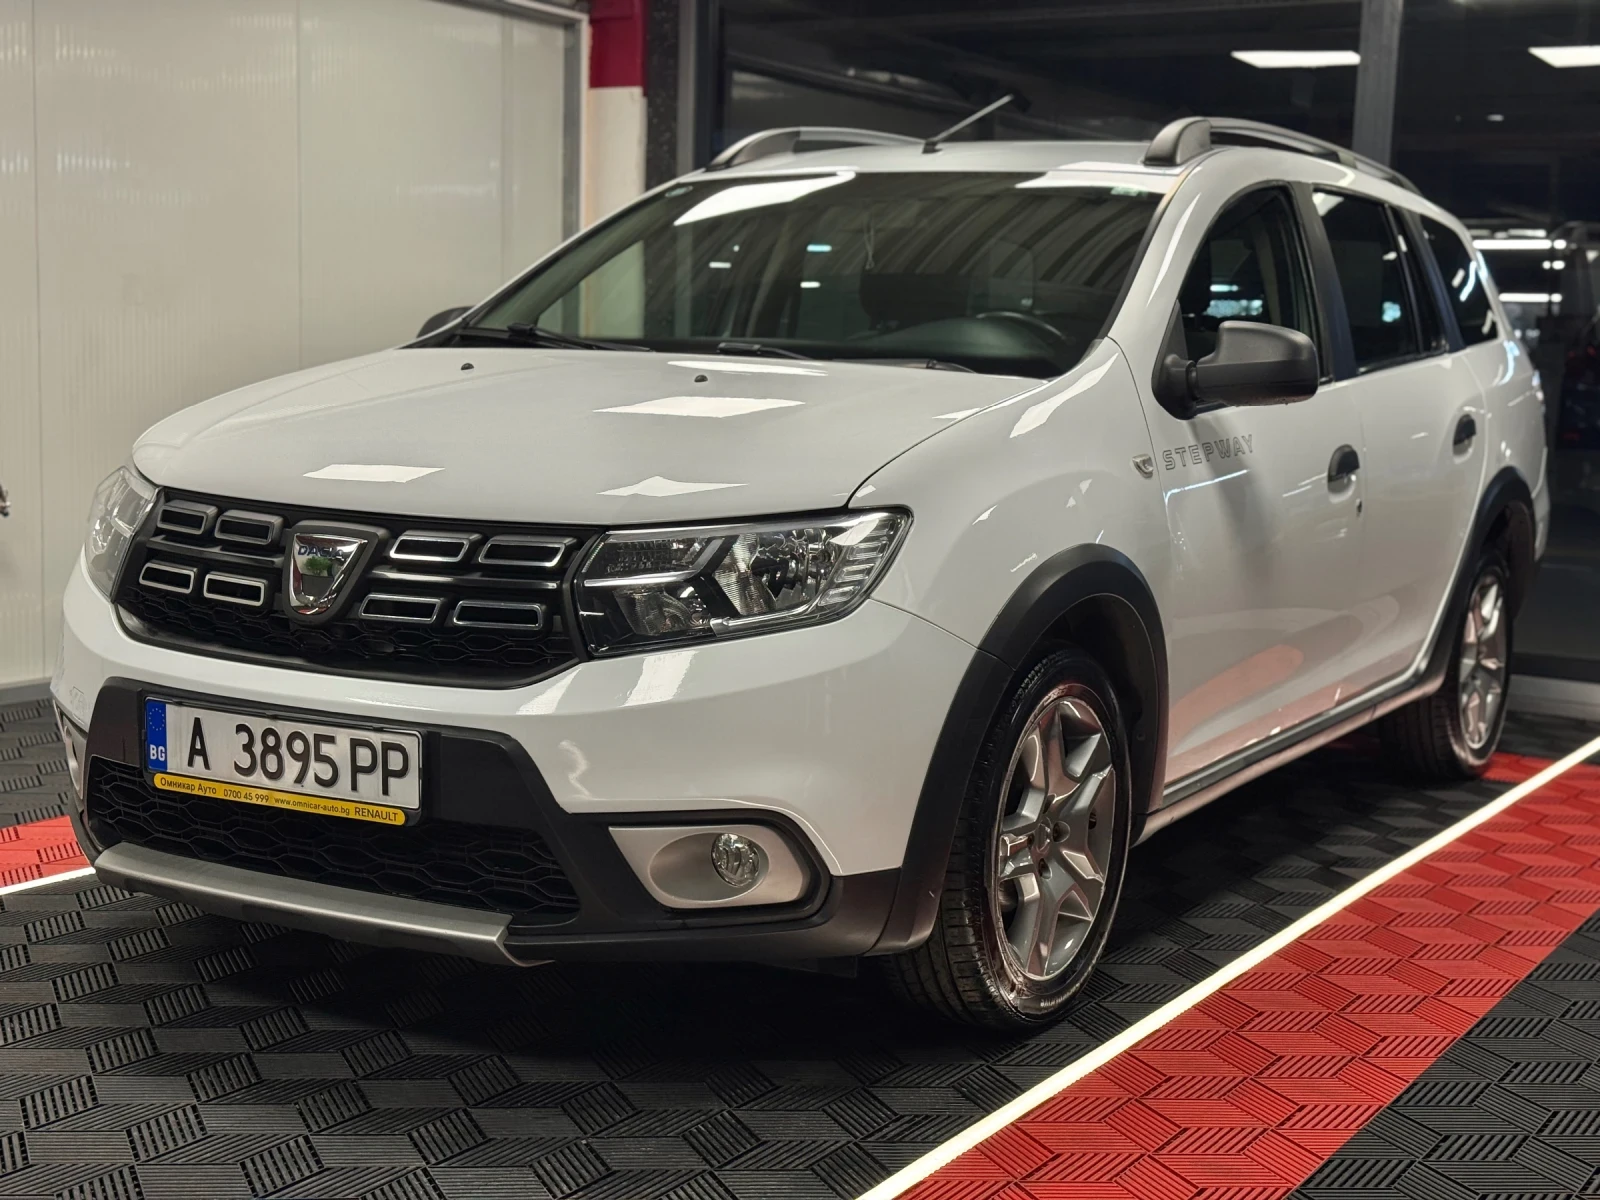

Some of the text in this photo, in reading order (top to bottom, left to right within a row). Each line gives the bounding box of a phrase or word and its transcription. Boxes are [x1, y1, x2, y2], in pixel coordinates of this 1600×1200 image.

[1162, 434, 1253, 471] STEPWAY
[298, 545, 344, 559] DACIA
[150, 744, 166, 762] BG
[187, 716, 409, 796] A 3895 PP
[160, 777, 398, 822] Омникар Ауто 0700 45 999 www.omnicar-auto.bg RENAULT
